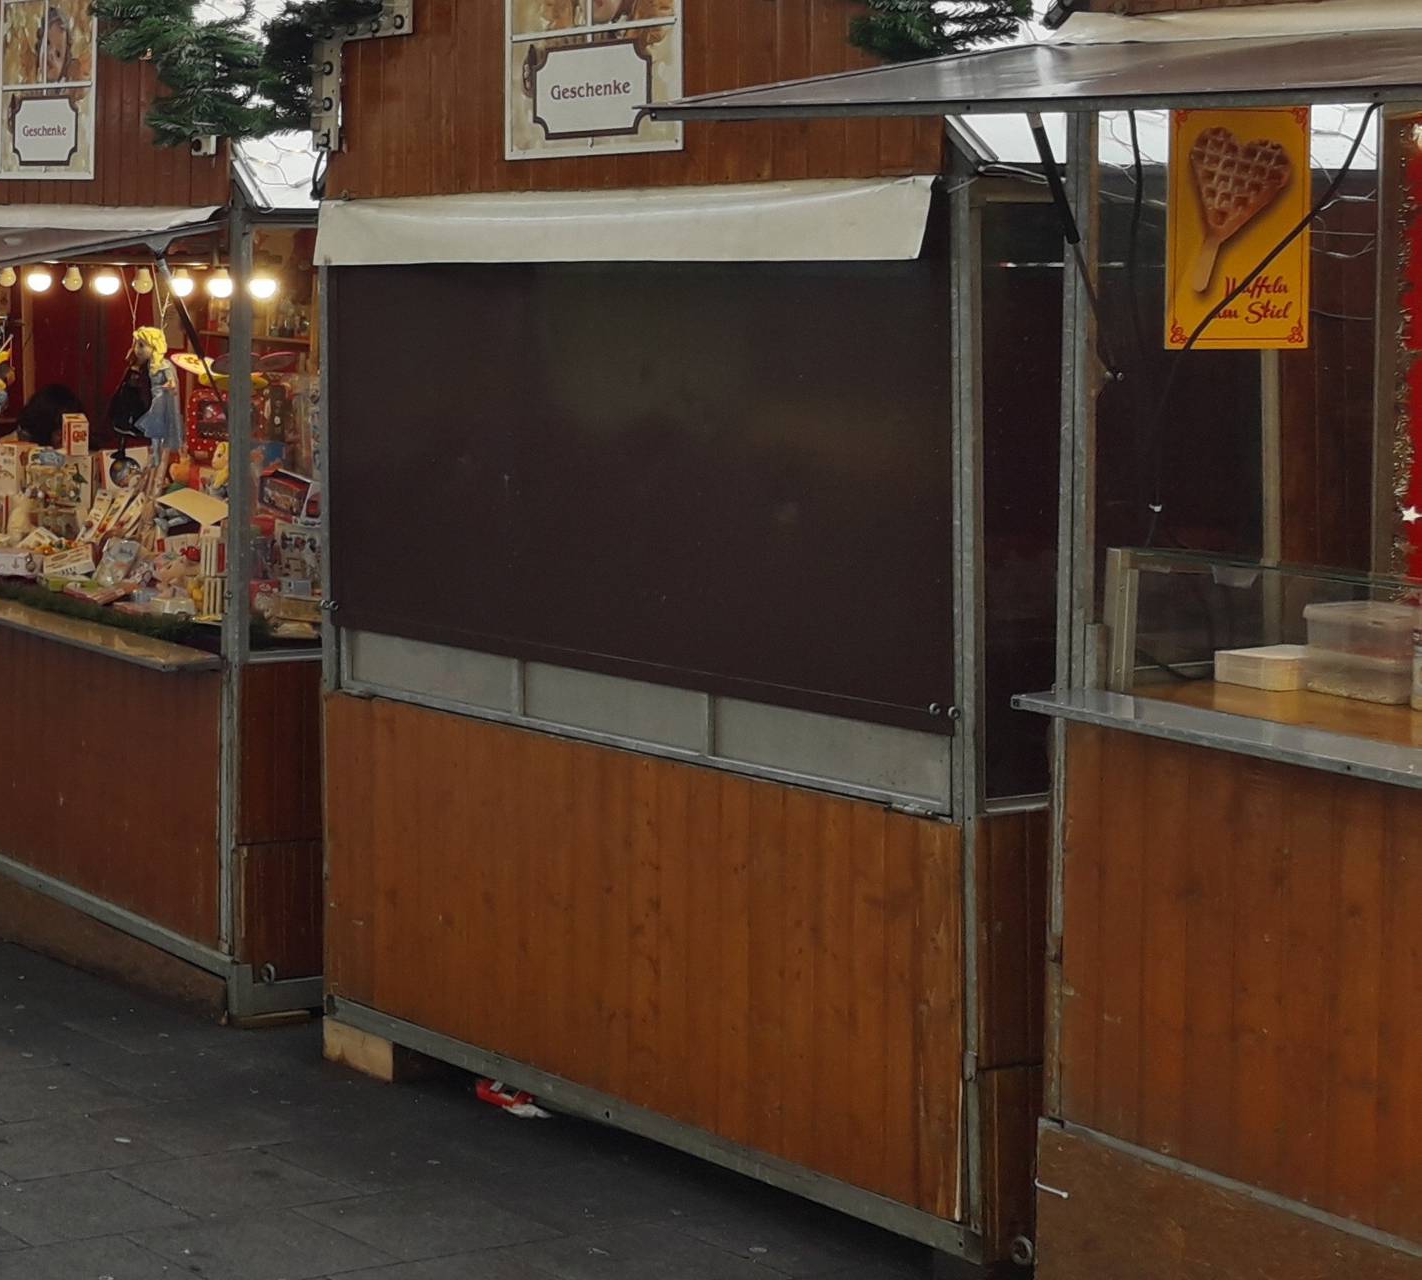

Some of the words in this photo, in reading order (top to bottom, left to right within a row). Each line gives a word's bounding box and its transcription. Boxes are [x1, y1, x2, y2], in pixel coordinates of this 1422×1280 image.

[550, 80, 631, 100] Geschenke
[22, 125, 67, 137] Geschenke
[1245, 300, 1293, 324] Stiel
